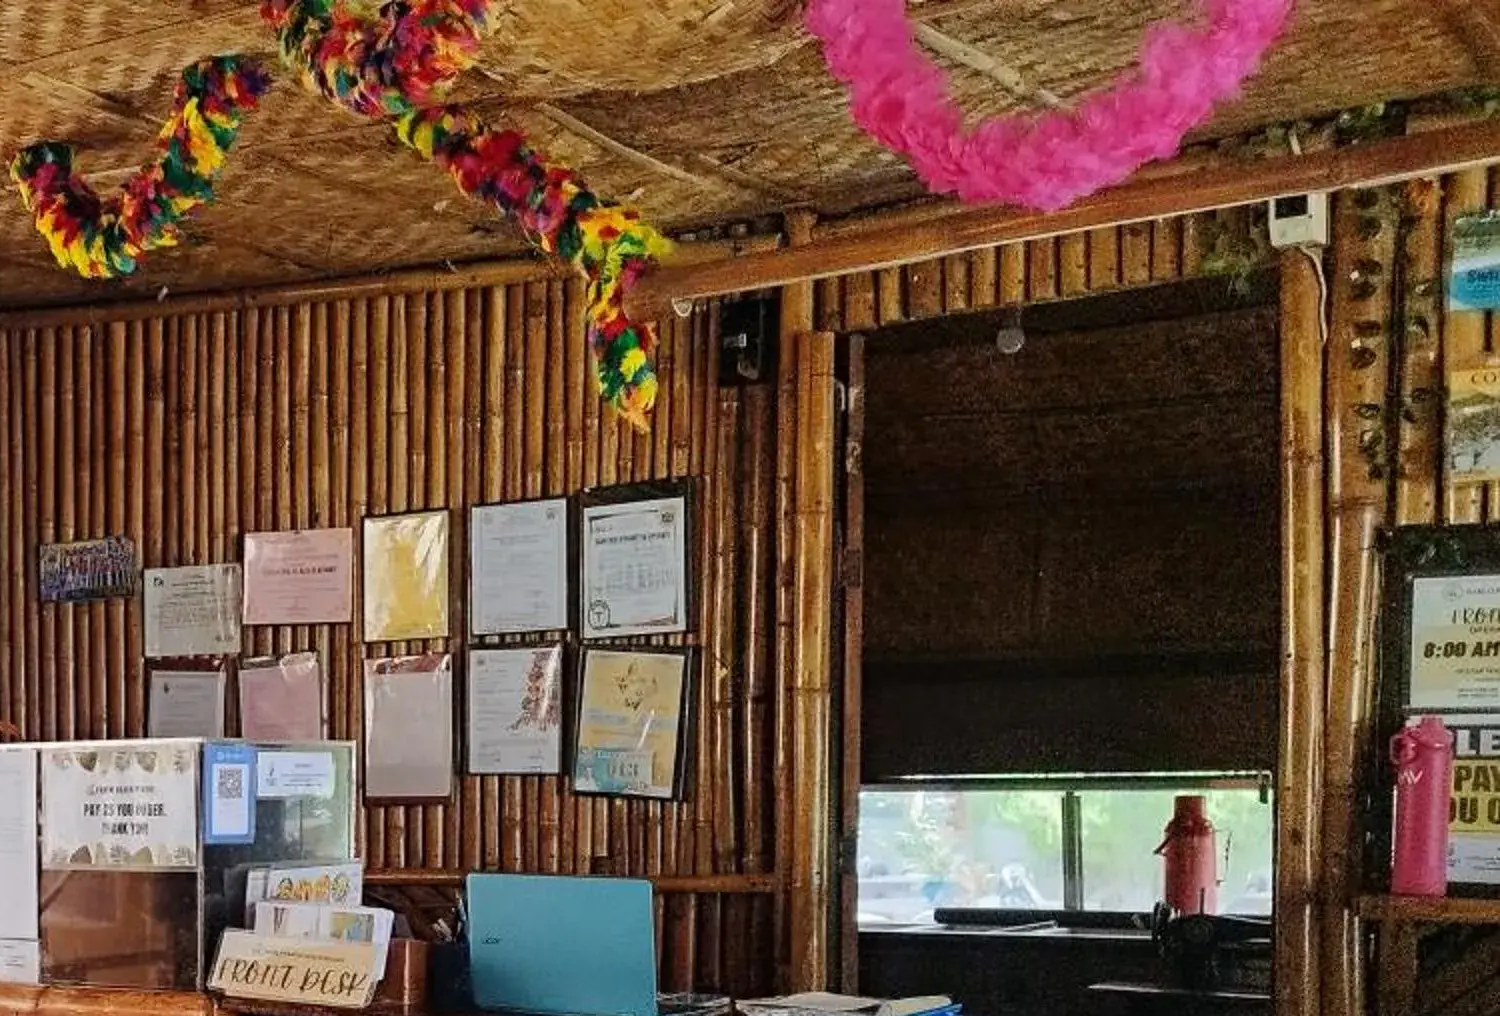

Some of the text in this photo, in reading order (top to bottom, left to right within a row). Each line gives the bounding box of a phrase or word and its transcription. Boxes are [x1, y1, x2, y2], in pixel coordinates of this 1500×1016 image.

[1423, 641, 1467, 659] 8:00
[1445, 728, 1500, 758] LE
[83, 803, 101, 817] PAY
[117, 803, 134, 817] YOU
[218, 959, 371, 997] FRONT DESK
